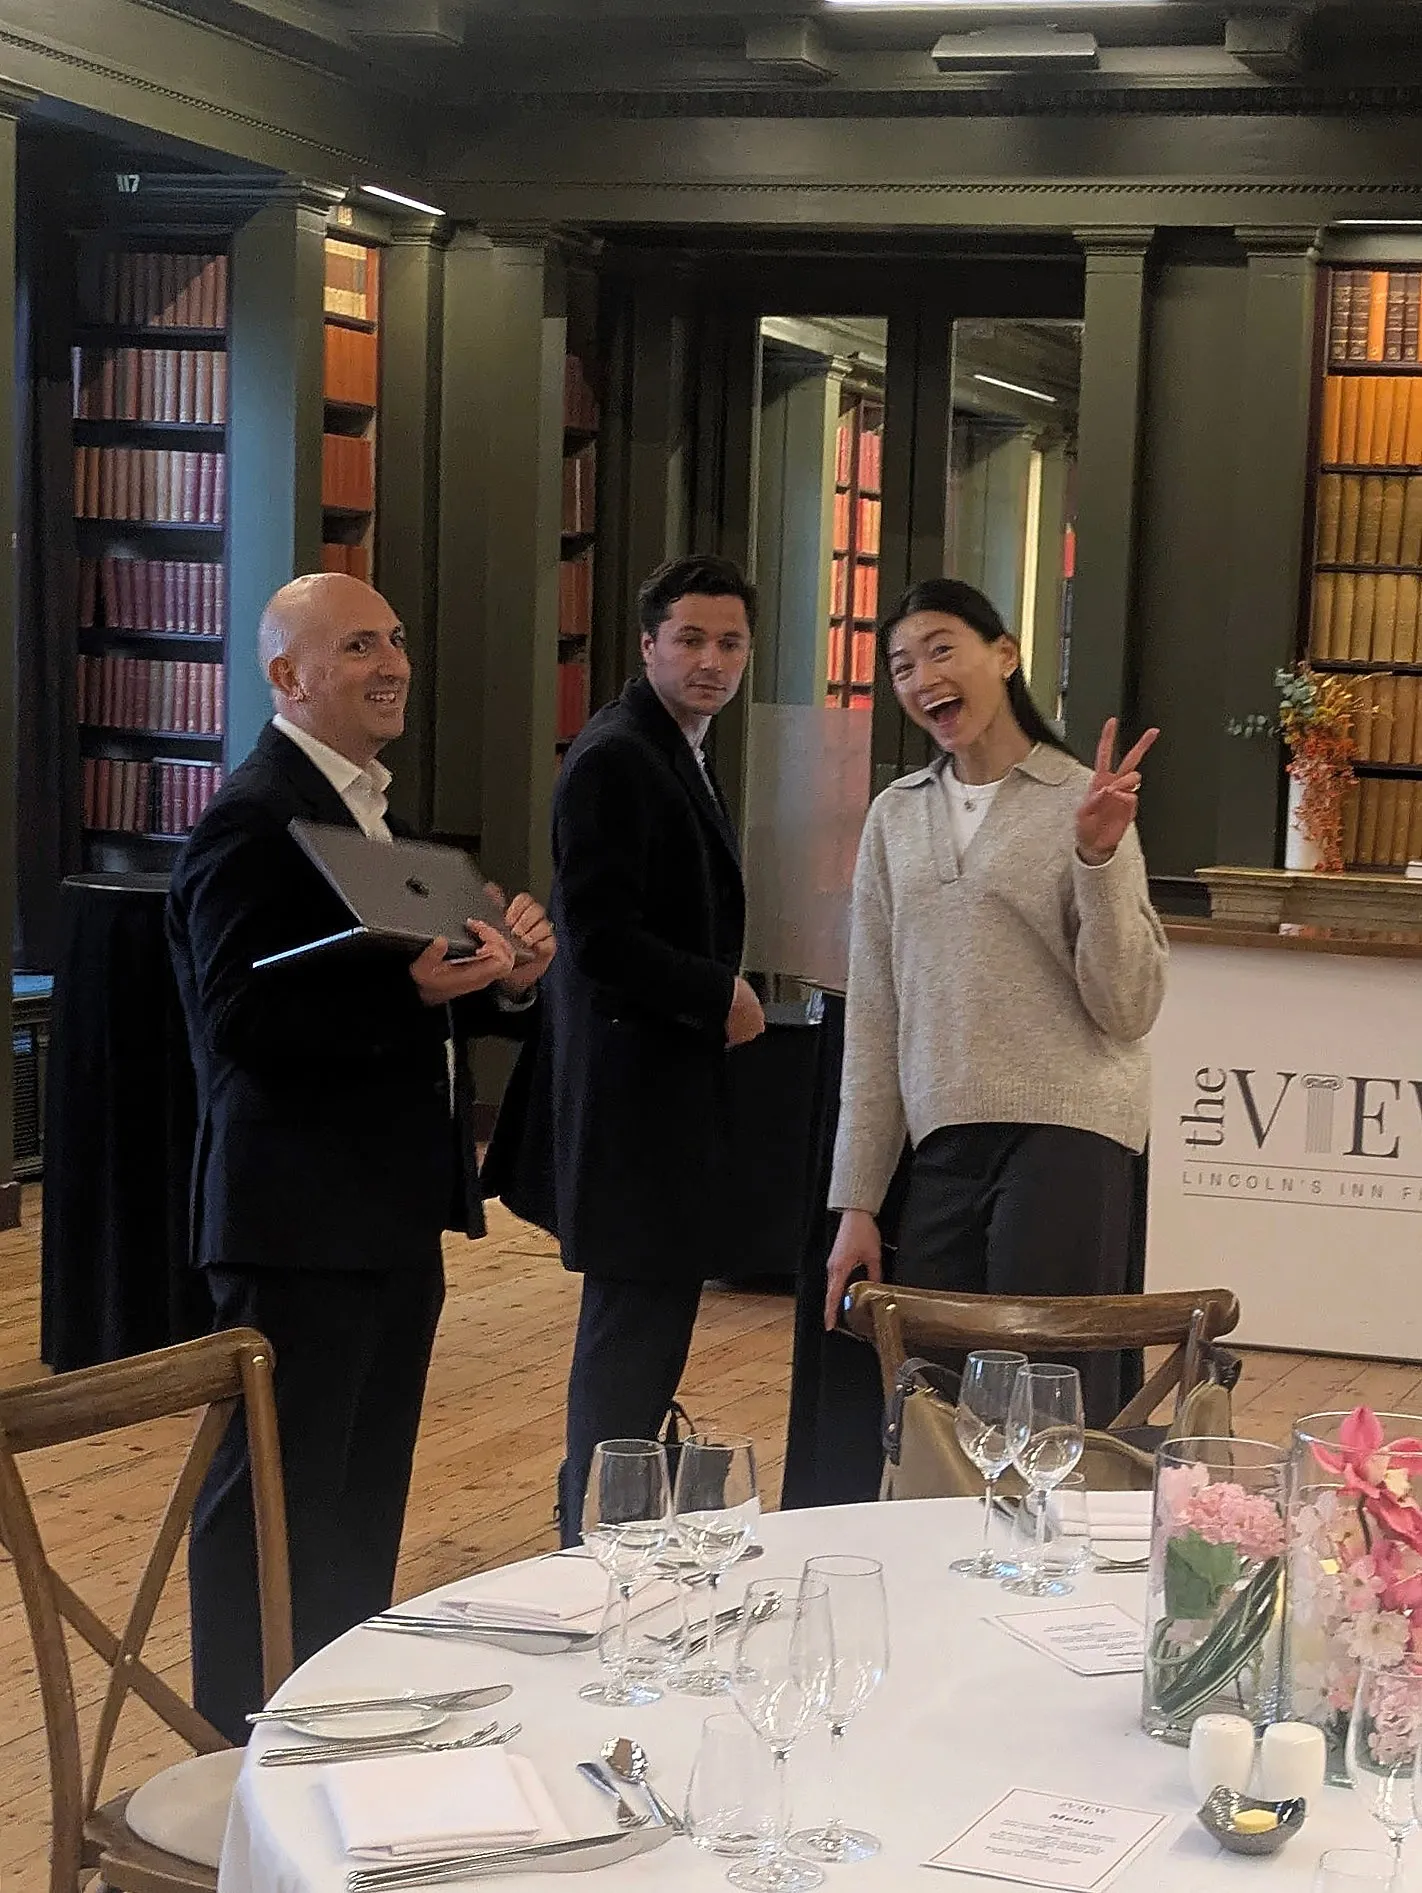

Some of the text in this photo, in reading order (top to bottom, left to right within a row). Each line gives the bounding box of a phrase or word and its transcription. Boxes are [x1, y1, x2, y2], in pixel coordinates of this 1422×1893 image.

[1180, 1067, 1422, 1159] the VIE
[1183, 1171, 1322, 1195] LINCOLN'S
[1340, 1182, 1385, 1198] INN
[1048, 1813, 1095, 1825] Menu
